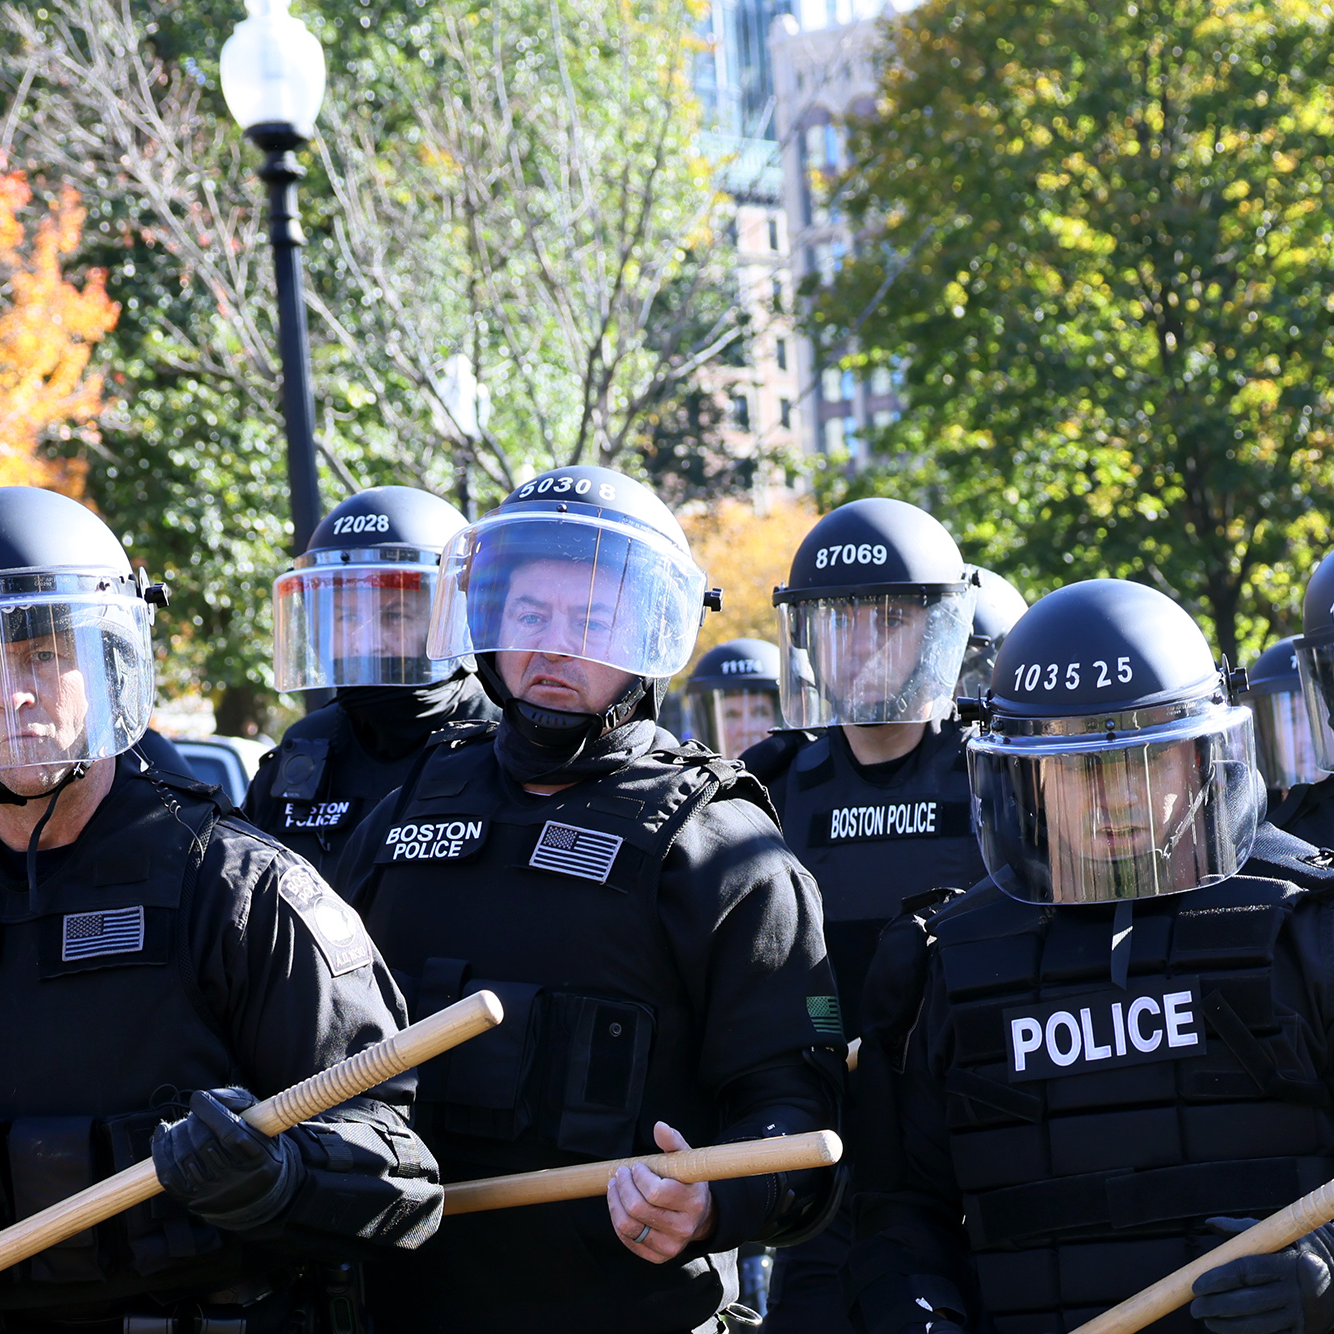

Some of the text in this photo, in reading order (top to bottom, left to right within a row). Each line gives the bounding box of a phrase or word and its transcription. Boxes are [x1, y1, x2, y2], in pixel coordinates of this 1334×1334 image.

[517, 477, 617, 501] 50308
[333, 514, 390, 535] 12028
[815, 543, 888, 570] 87069
[1013, 656, 1134, 692] 103525
[284, 801, 350, 816] BTON
[830, 801, 937, 840] BOSTON POLICE
[385, 820, 483, 846] BOSTON
[392, 839, 464, 861] POLICE
[1010, 990, 1200, 1072] POLICE
